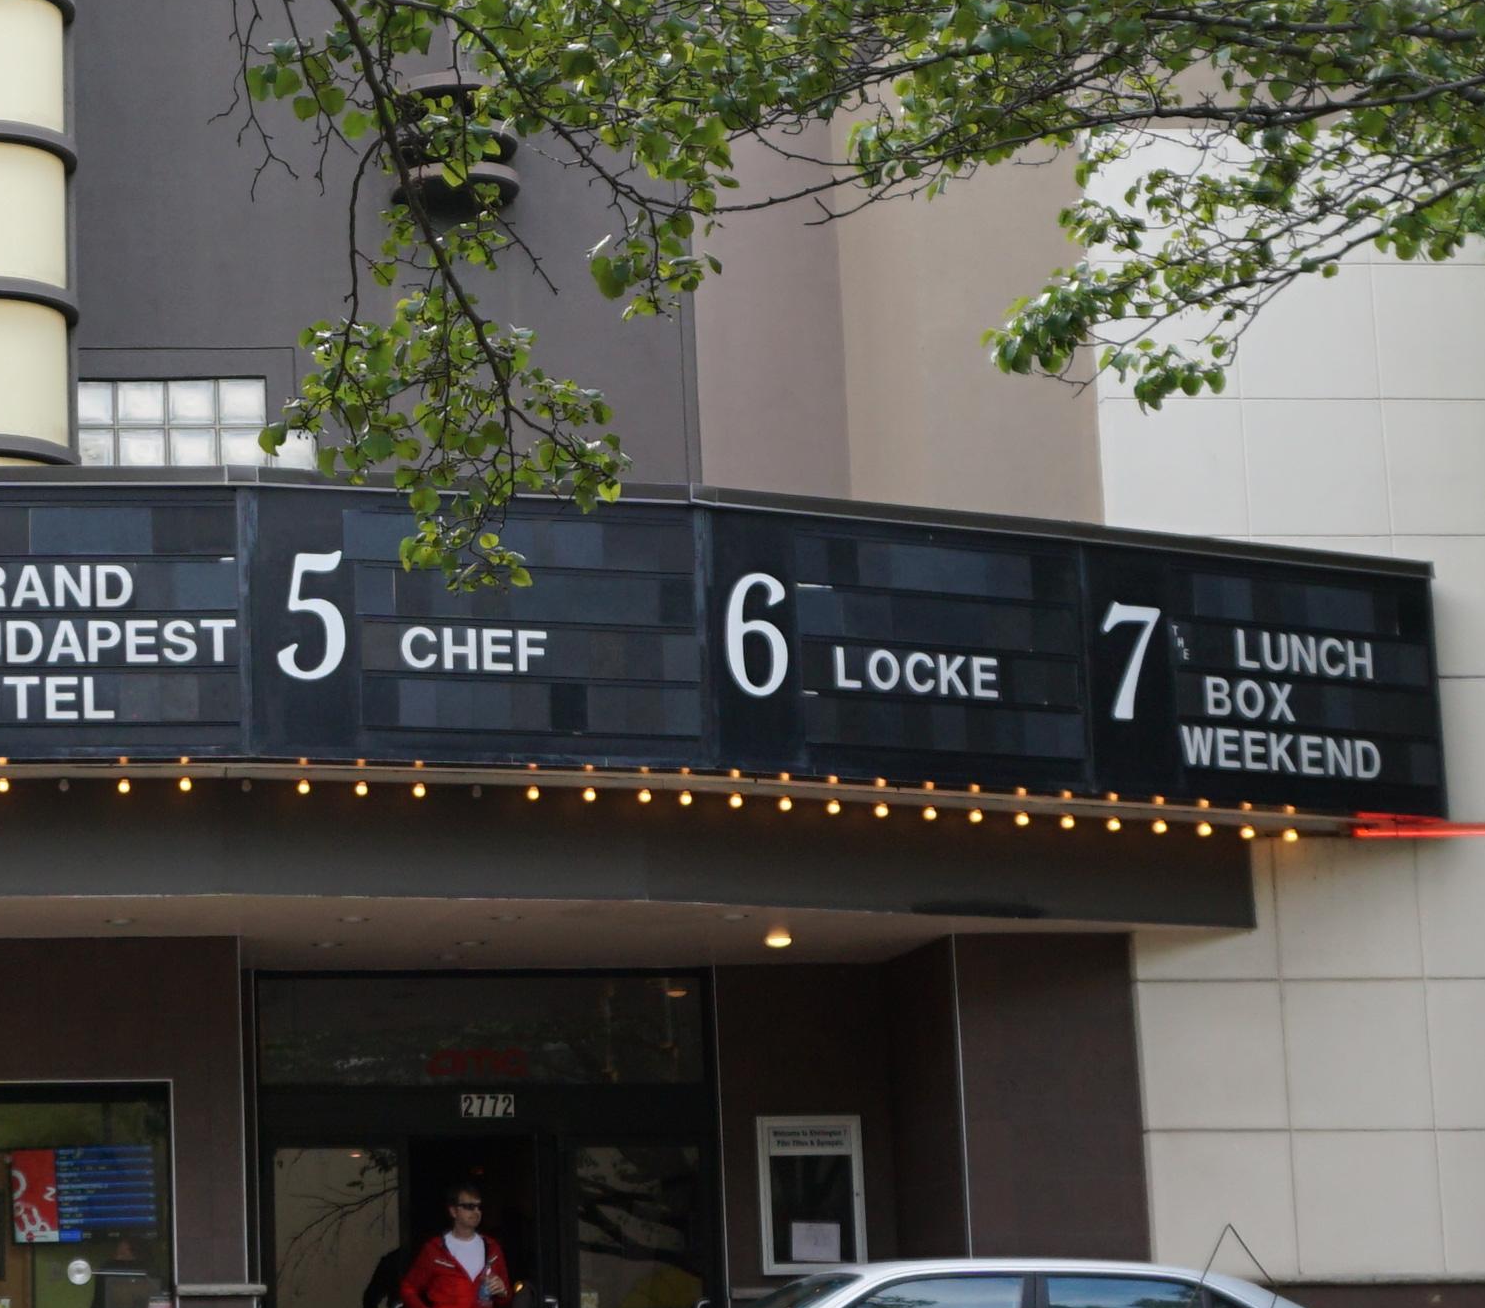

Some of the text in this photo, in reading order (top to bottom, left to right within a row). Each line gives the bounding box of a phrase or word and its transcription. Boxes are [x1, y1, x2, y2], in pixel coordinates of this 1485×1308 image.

[276, 550, 347, 682] 5
[725, 572, 790, 698] 6
[1172, 624, 1190, 661] THE
[400, 627, 549, 674] CHEF
[833, 645, 1001, 701] LOCKE
[1100, 602, 1162, 721] 7
[1234, 628, 1374, 681] LUNCH
[1205, 675, 1293, 723] BOX
[1179, 724, 1382, 781] WEEKEND
[462, 1095, 513, 1118] 2772
